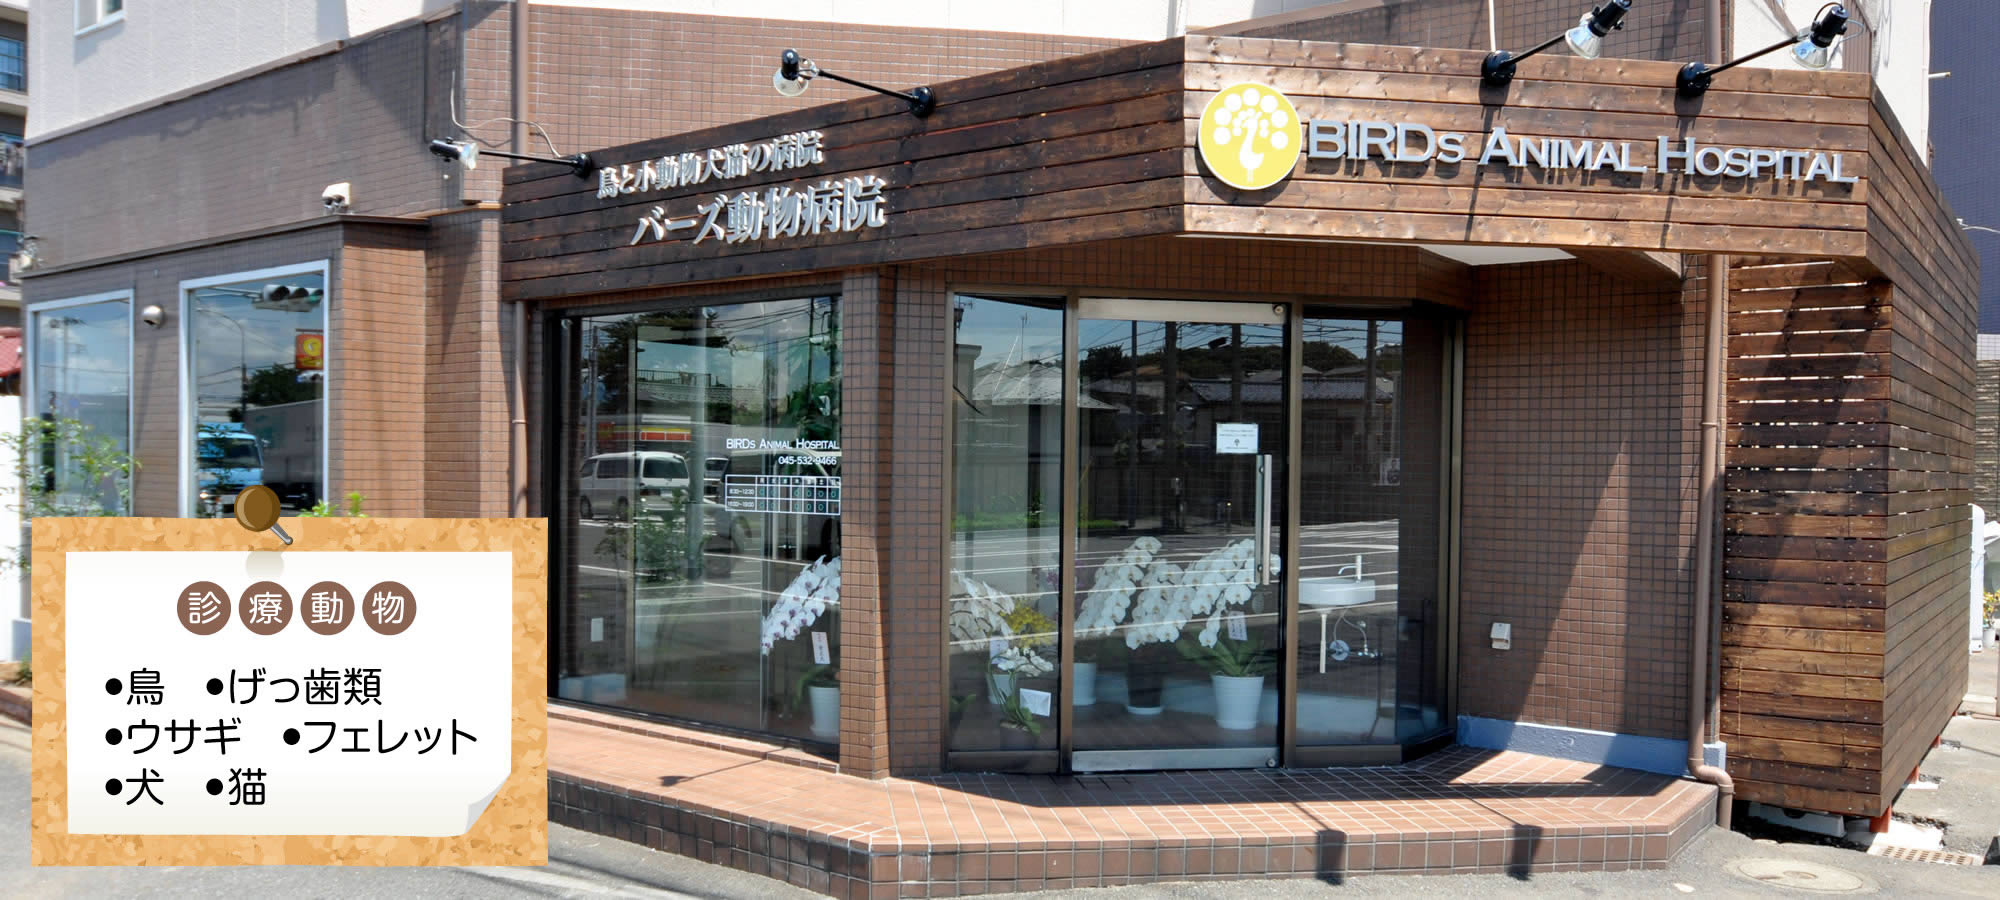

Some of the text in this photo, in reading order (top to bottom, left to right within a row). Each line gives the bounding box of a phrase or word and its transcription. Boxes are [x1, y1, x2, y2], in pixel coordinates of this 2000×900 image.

[597, 130, 825, 199] 鳥と小動物犬猫の病院
[629, 175, 887, 245] バーズ動物病院
